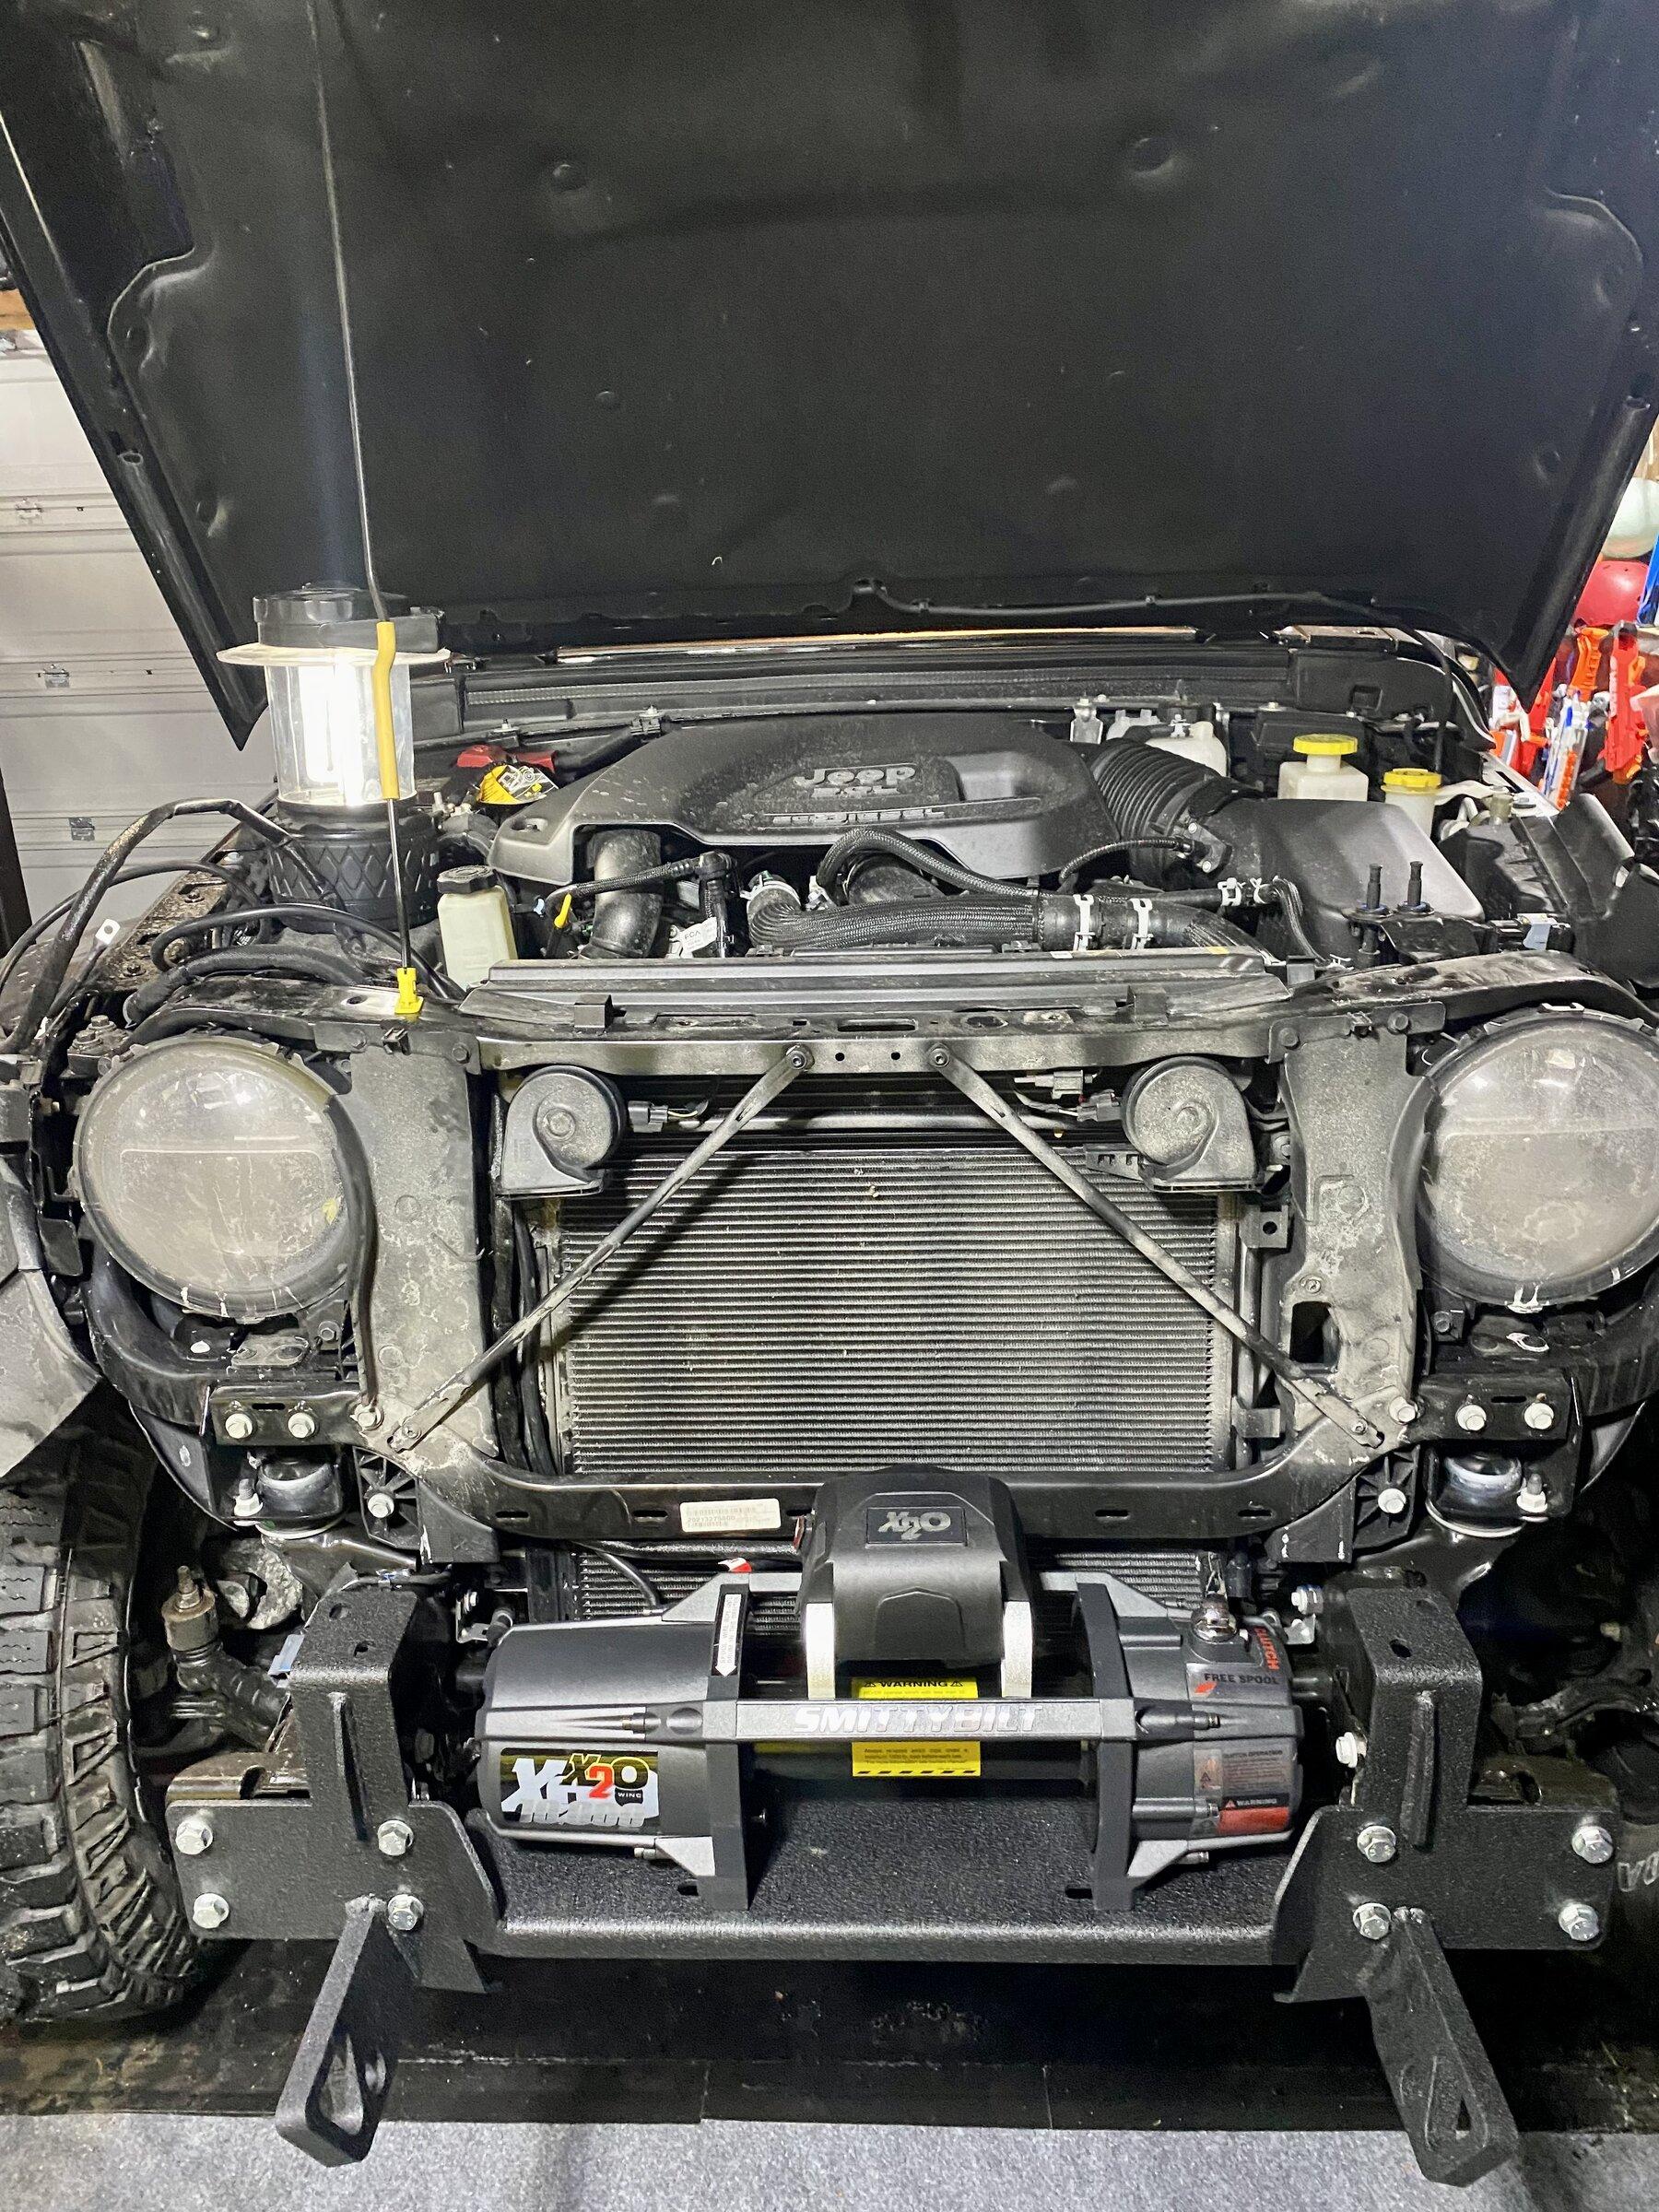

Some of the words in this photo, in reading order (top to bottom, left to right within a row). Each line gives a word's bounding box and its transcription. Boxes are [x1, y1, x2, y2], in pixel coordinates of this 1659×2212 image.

[793, 766, 917, 787] Jeep
[684, 930, 701, 940] FCA
[1253, 1626, 1280, 1670] CLUTCH
[1204, 1673, 1236, 1683] FREE
[1239, 1675, 1279, 1685] SPOOL
[794, 1705, 1043, 1733] SMITTYBILT
